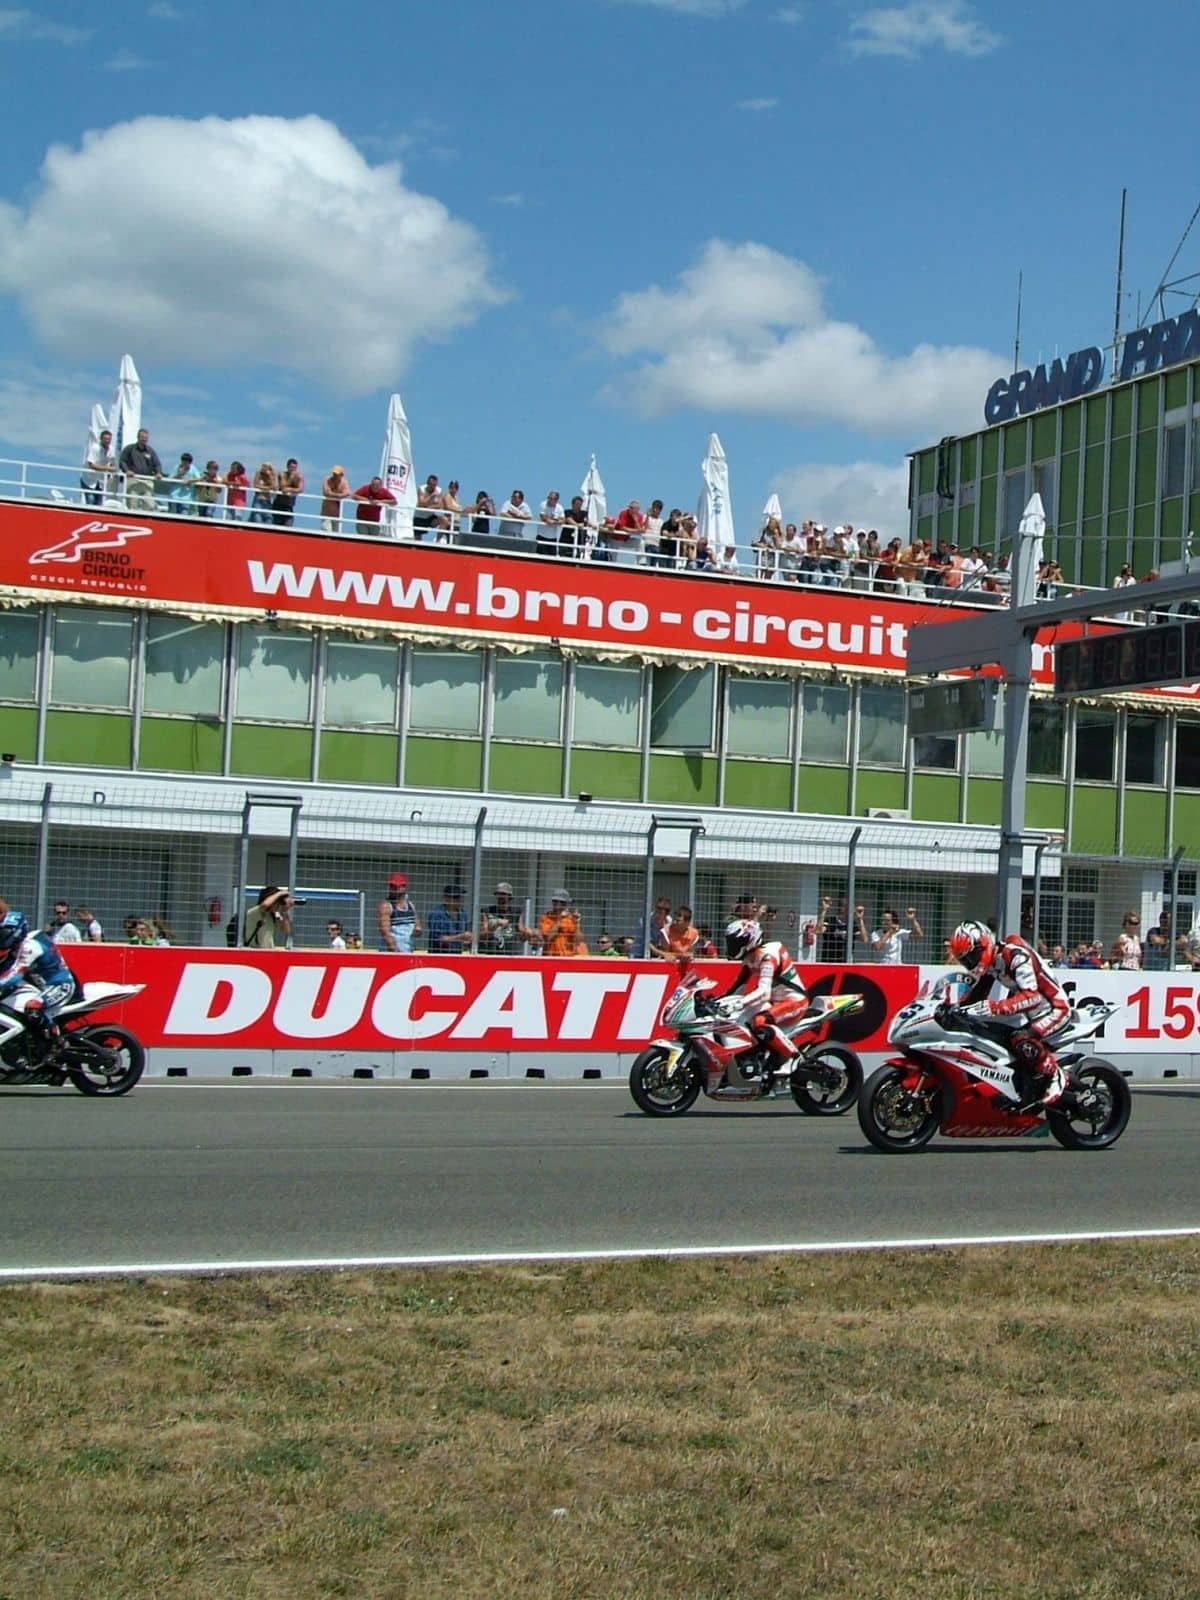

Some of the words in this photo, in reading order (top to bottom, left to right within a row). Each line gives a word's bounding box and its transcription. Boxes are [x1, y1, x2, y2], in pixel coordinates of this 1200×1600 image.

[985, 346, 1105, 426] GRAND
[83, 550, 130, 566] BRNO
[82, 563, 145, 580] CIRCUIT
[163, 962, 669, 1041] DUCATI
[979, 1067, 1011, 1083] YAMAHA
